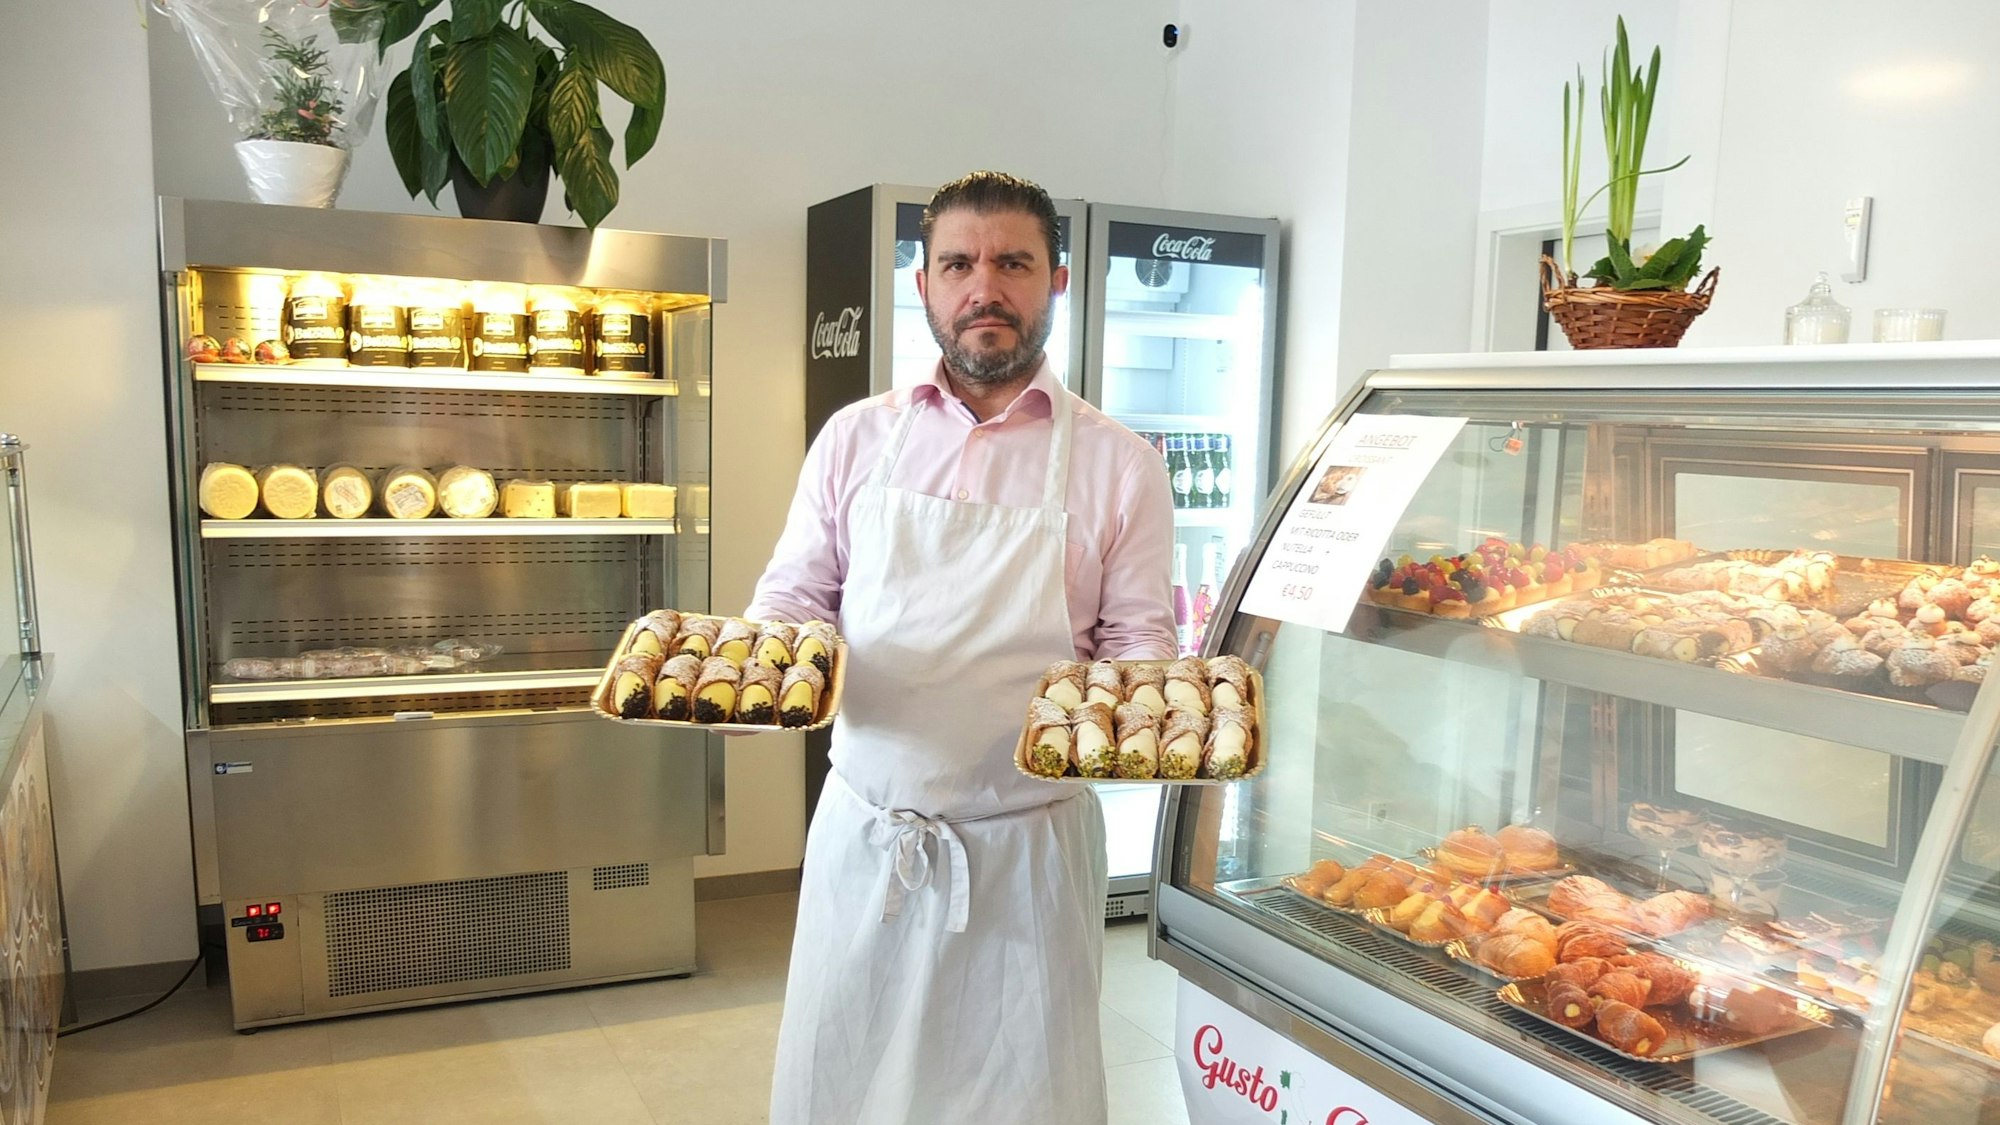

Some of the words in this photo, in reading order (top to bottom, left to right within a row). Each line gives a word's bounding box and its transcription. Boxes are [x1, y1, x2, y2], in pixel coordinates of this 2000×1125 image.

[1359, 434, 1417, 447] ANGEBOT
[1290, 527, 1304, 536] MIT
[1304, 529, 1336, 540] RICOTTA
[1336, 531, 1360, 542] ODER
[1282, 543, 1314, 554] NUTELLA
[1272, 560, 1319, 574] CAPPUCCINO
[1282, 584, 1313, 600] €4,50
[1193, 1024, 1279, 1113] Gusto
